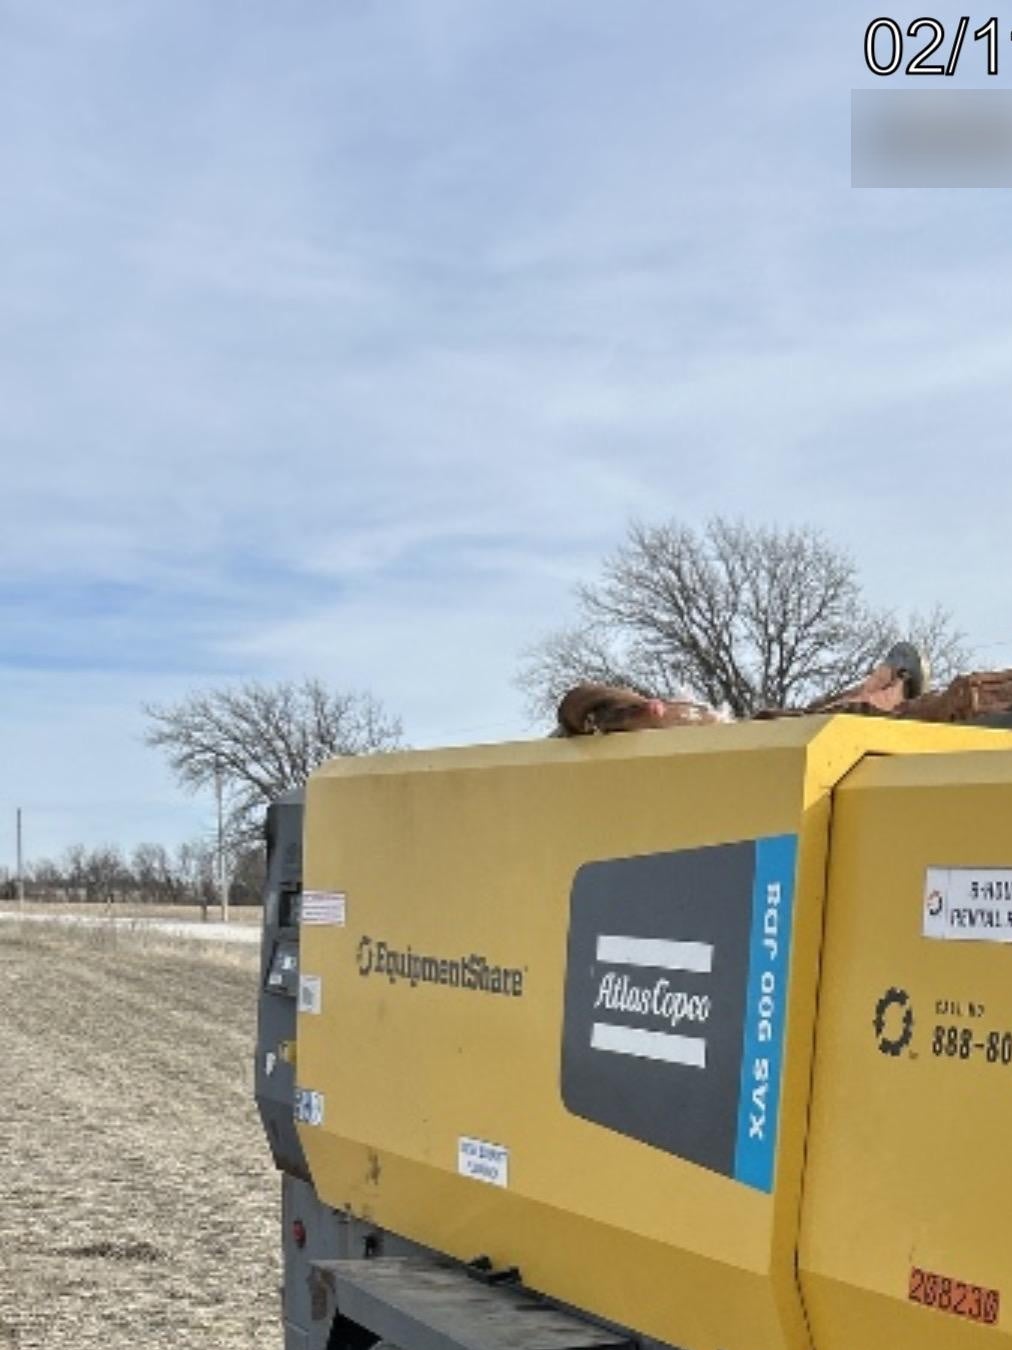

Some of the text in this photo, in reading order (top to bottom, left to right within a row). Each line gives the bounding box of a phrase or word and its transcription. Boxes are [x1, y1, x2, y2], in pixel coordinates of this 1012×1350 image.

[375, 941, 523, 997] EquipmentShare
[757, 970, 775, 1042] 900
[749, 1058, 769, 1140] XAS
[909, 1268, 999, 1324] 208230
